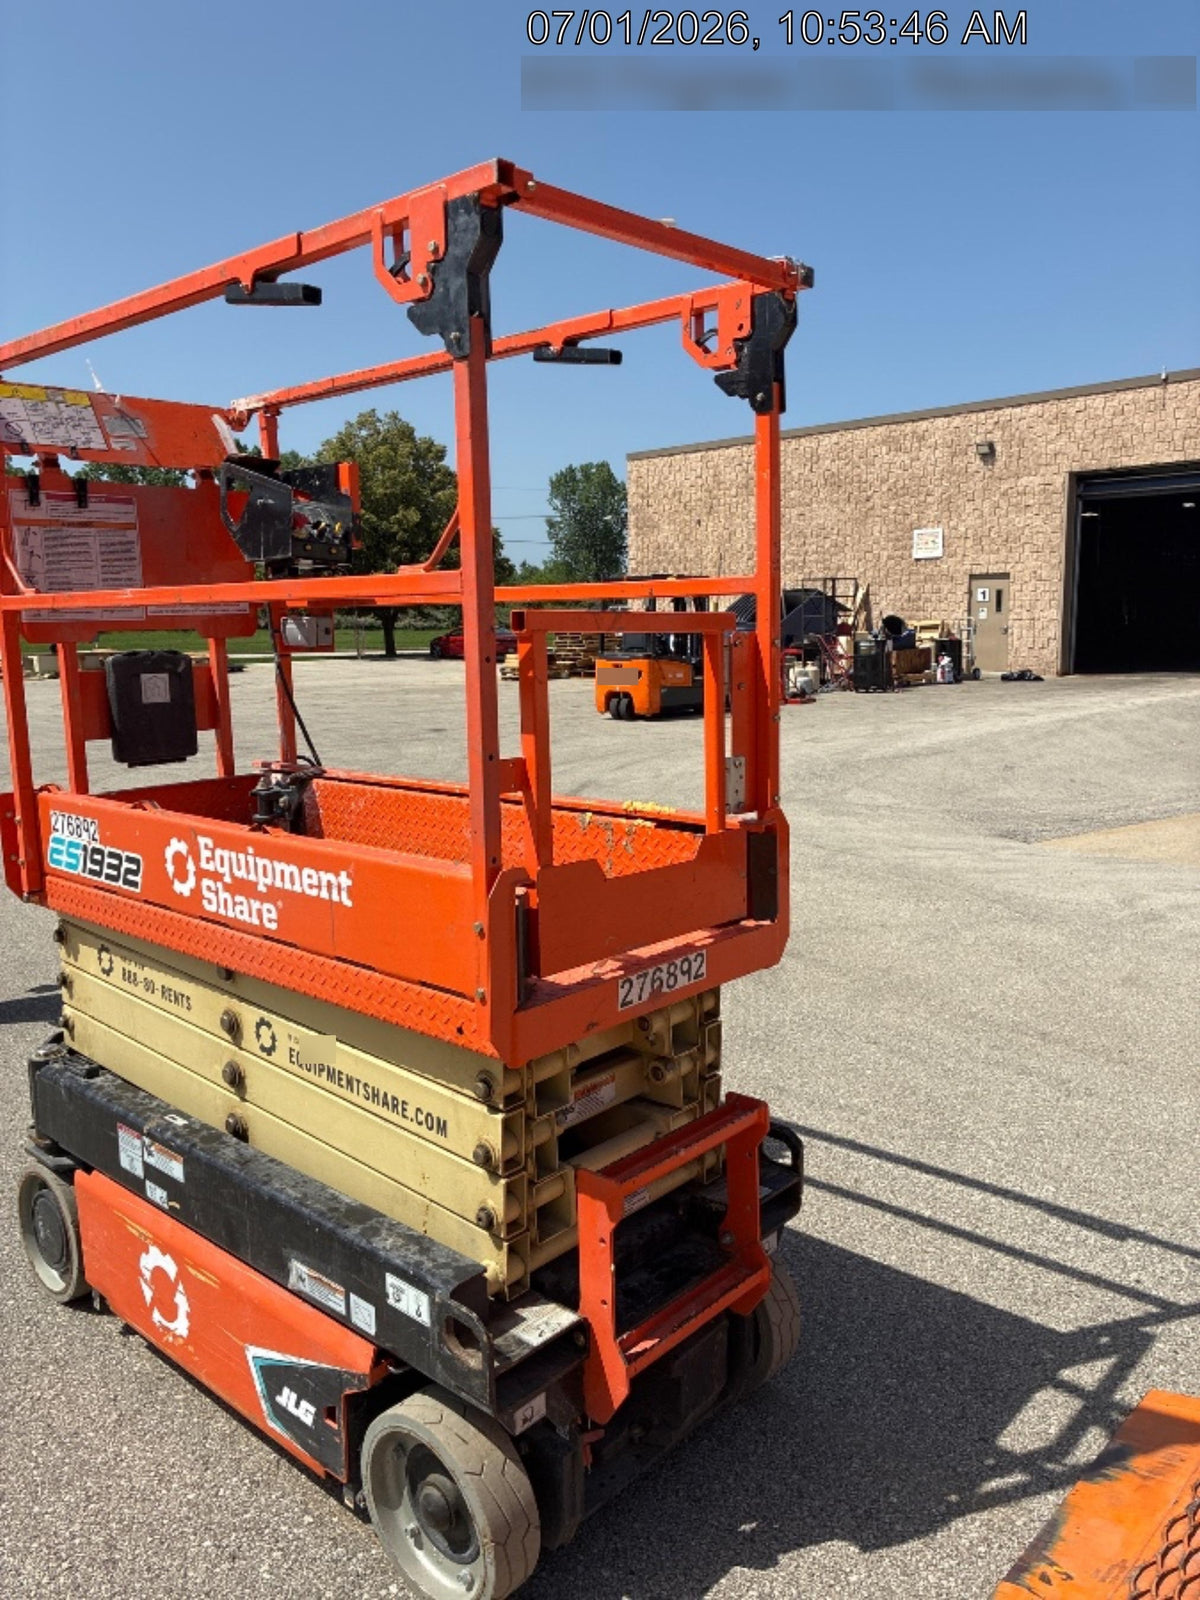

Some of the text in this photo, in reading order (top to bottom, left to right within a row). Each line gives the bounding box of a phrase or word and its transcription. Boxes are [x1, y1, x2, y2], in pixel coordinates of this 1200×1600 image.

[51, 811, 98, 842] 276892
[49, 835, 142, 891] ES1932
[197, 835, 353, 908] Equipment
[620, 952, 705, 1009] 276892
[275, 1386, 317, 1427] JLG
